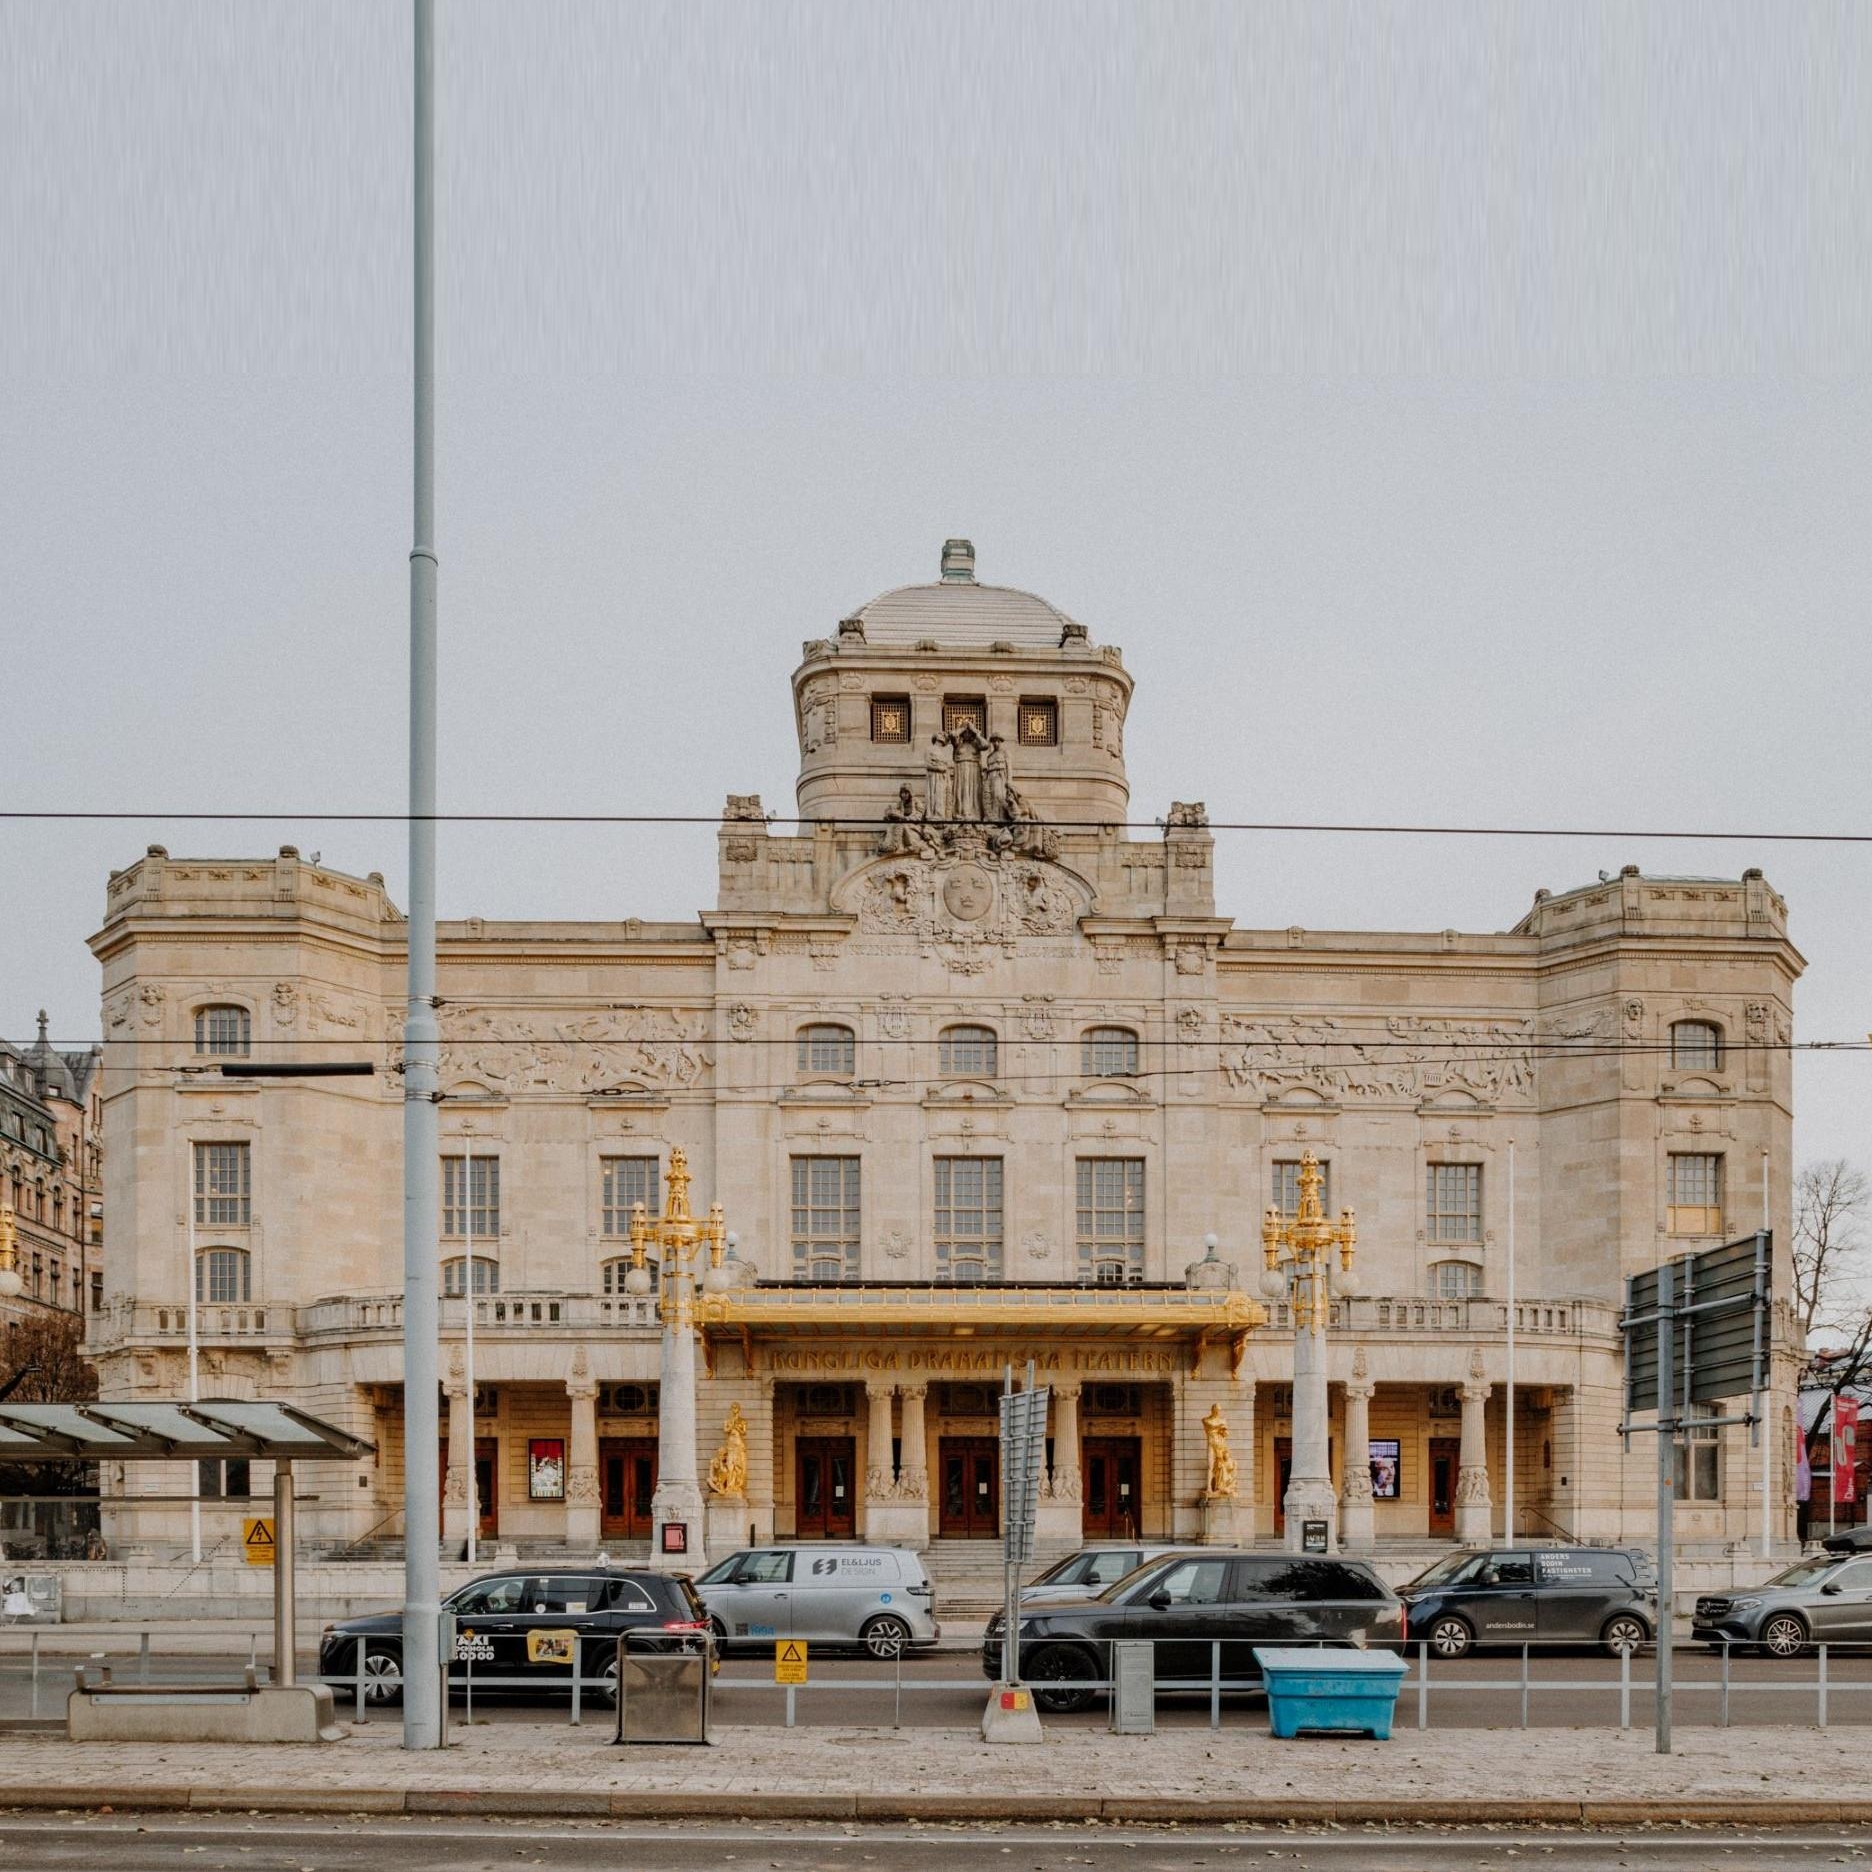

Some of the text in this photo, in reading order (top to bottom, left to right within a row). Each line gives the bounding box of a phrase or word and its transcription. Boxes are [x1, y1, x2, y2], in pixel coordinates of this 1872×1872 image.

[774, 1350, 1175, 1371] KUNGLIGA DRAMATISKA TEATERN
[841, 1558, 882, 1566] EL&LJUS
[841, 1567, 876, 1576] DESIGN
[1486, 1621, 1535, 1629] andersbodin.se
